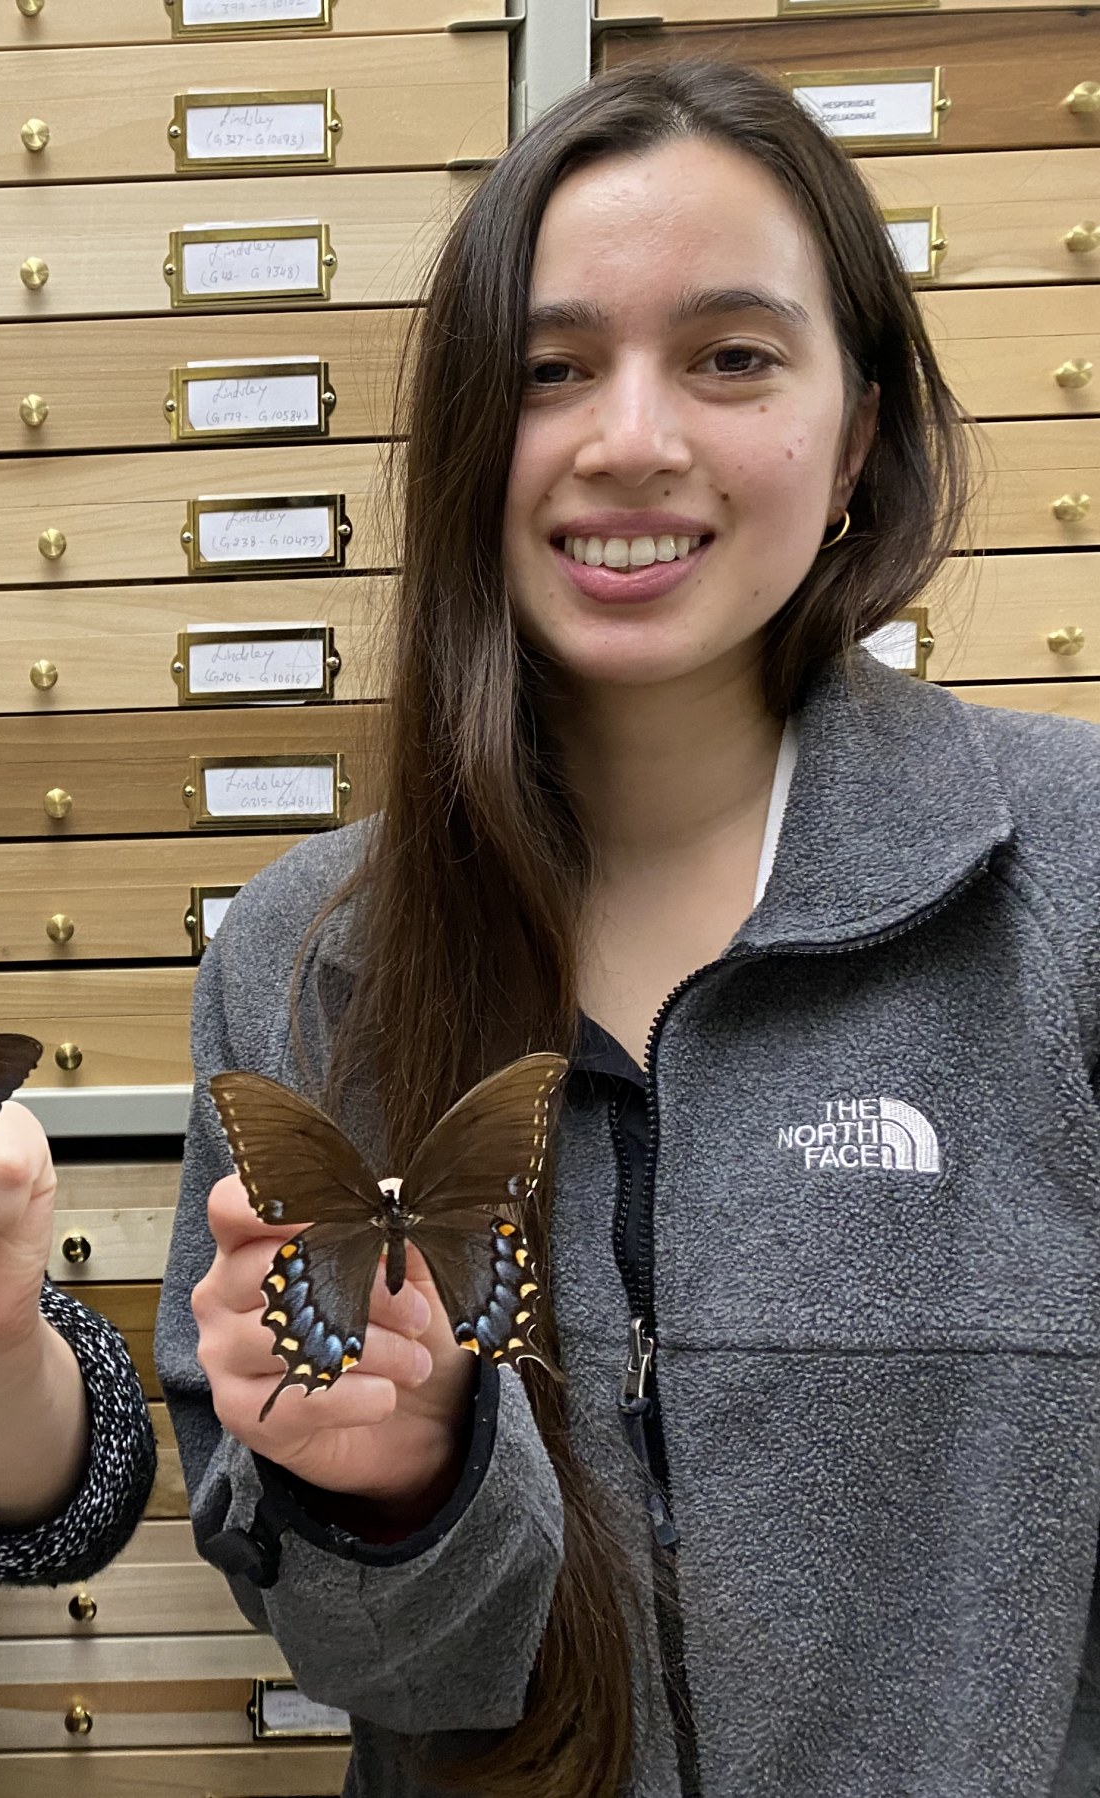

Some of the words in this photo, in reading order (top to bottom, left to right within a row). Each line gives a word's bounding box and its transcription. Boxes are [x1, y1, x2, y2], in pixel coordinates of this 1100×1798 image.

[818, 1098, 880, 1122] THE
[777, 1119, 879, 1150] NORTH
[804, 1144, 881, 1169] FACE
